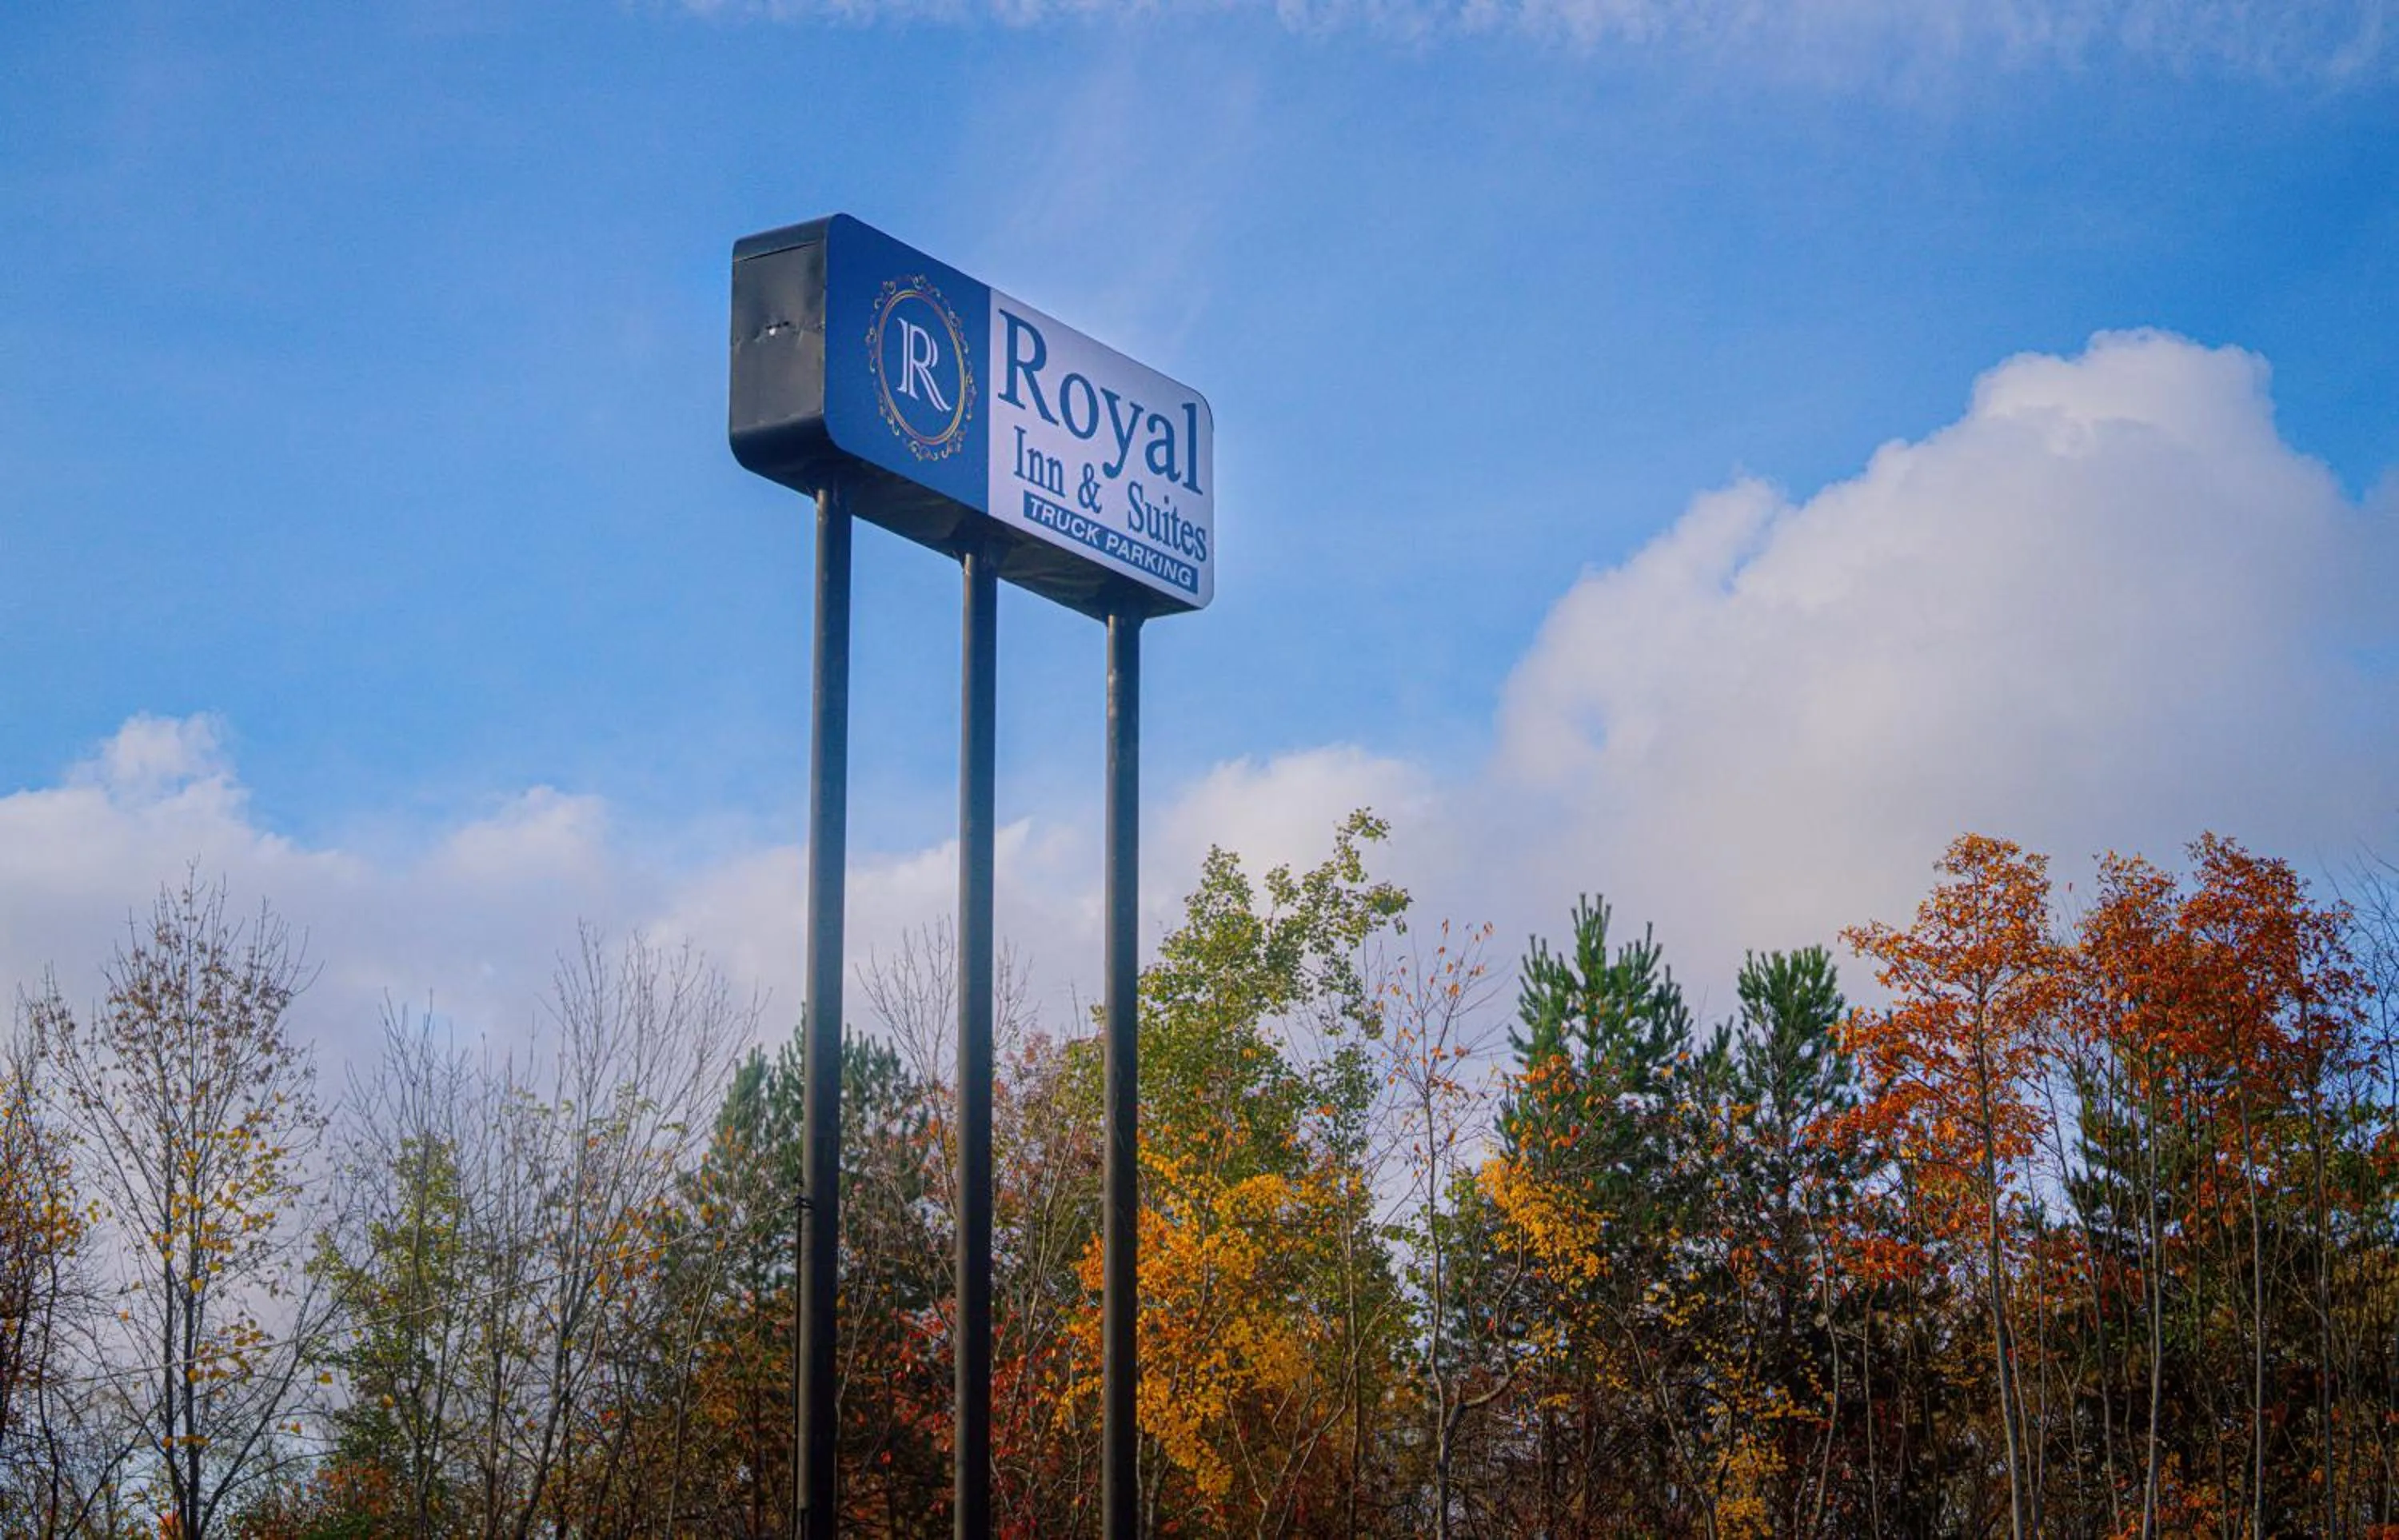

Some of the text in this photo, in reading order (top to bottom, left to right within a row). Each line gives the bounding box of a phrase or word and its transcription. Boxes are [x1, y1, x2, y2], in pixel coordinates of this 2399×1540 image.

[896, 317, 952, 412] R
[997, 308, 1203, 496] Royal
[1013, 425, 1207, 562] Inn & Suites
[1029, 497, 1192, 588] TRUCK PARKING
